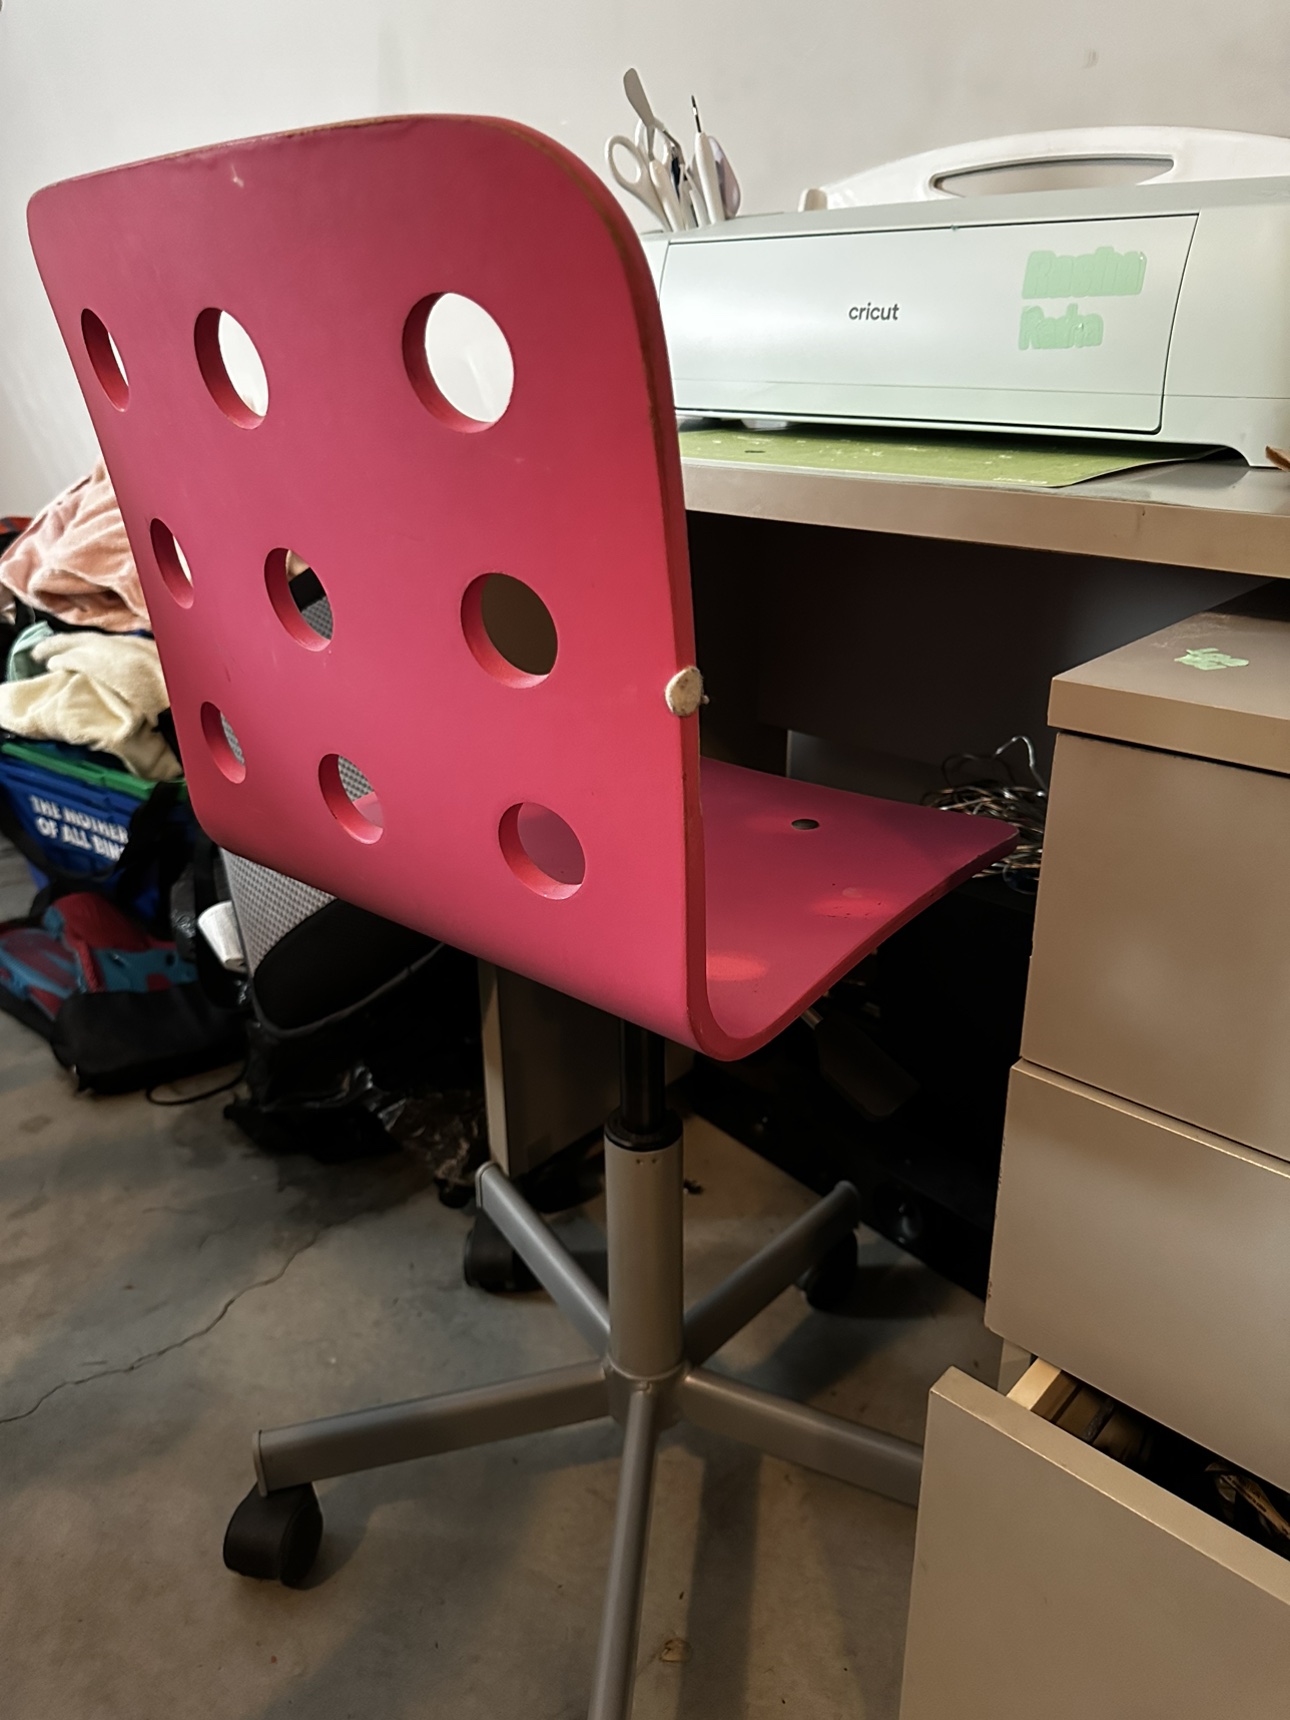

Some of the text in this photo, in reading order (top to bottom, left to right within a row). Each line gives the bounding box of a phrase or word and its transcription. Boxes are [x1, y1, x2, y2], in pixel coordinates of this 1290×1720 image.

[848, 302, 900, 321] cricut
[29, 794, 129, 845] THE MOTHER
[36, 816, 126, 862] OF ALL BIN
